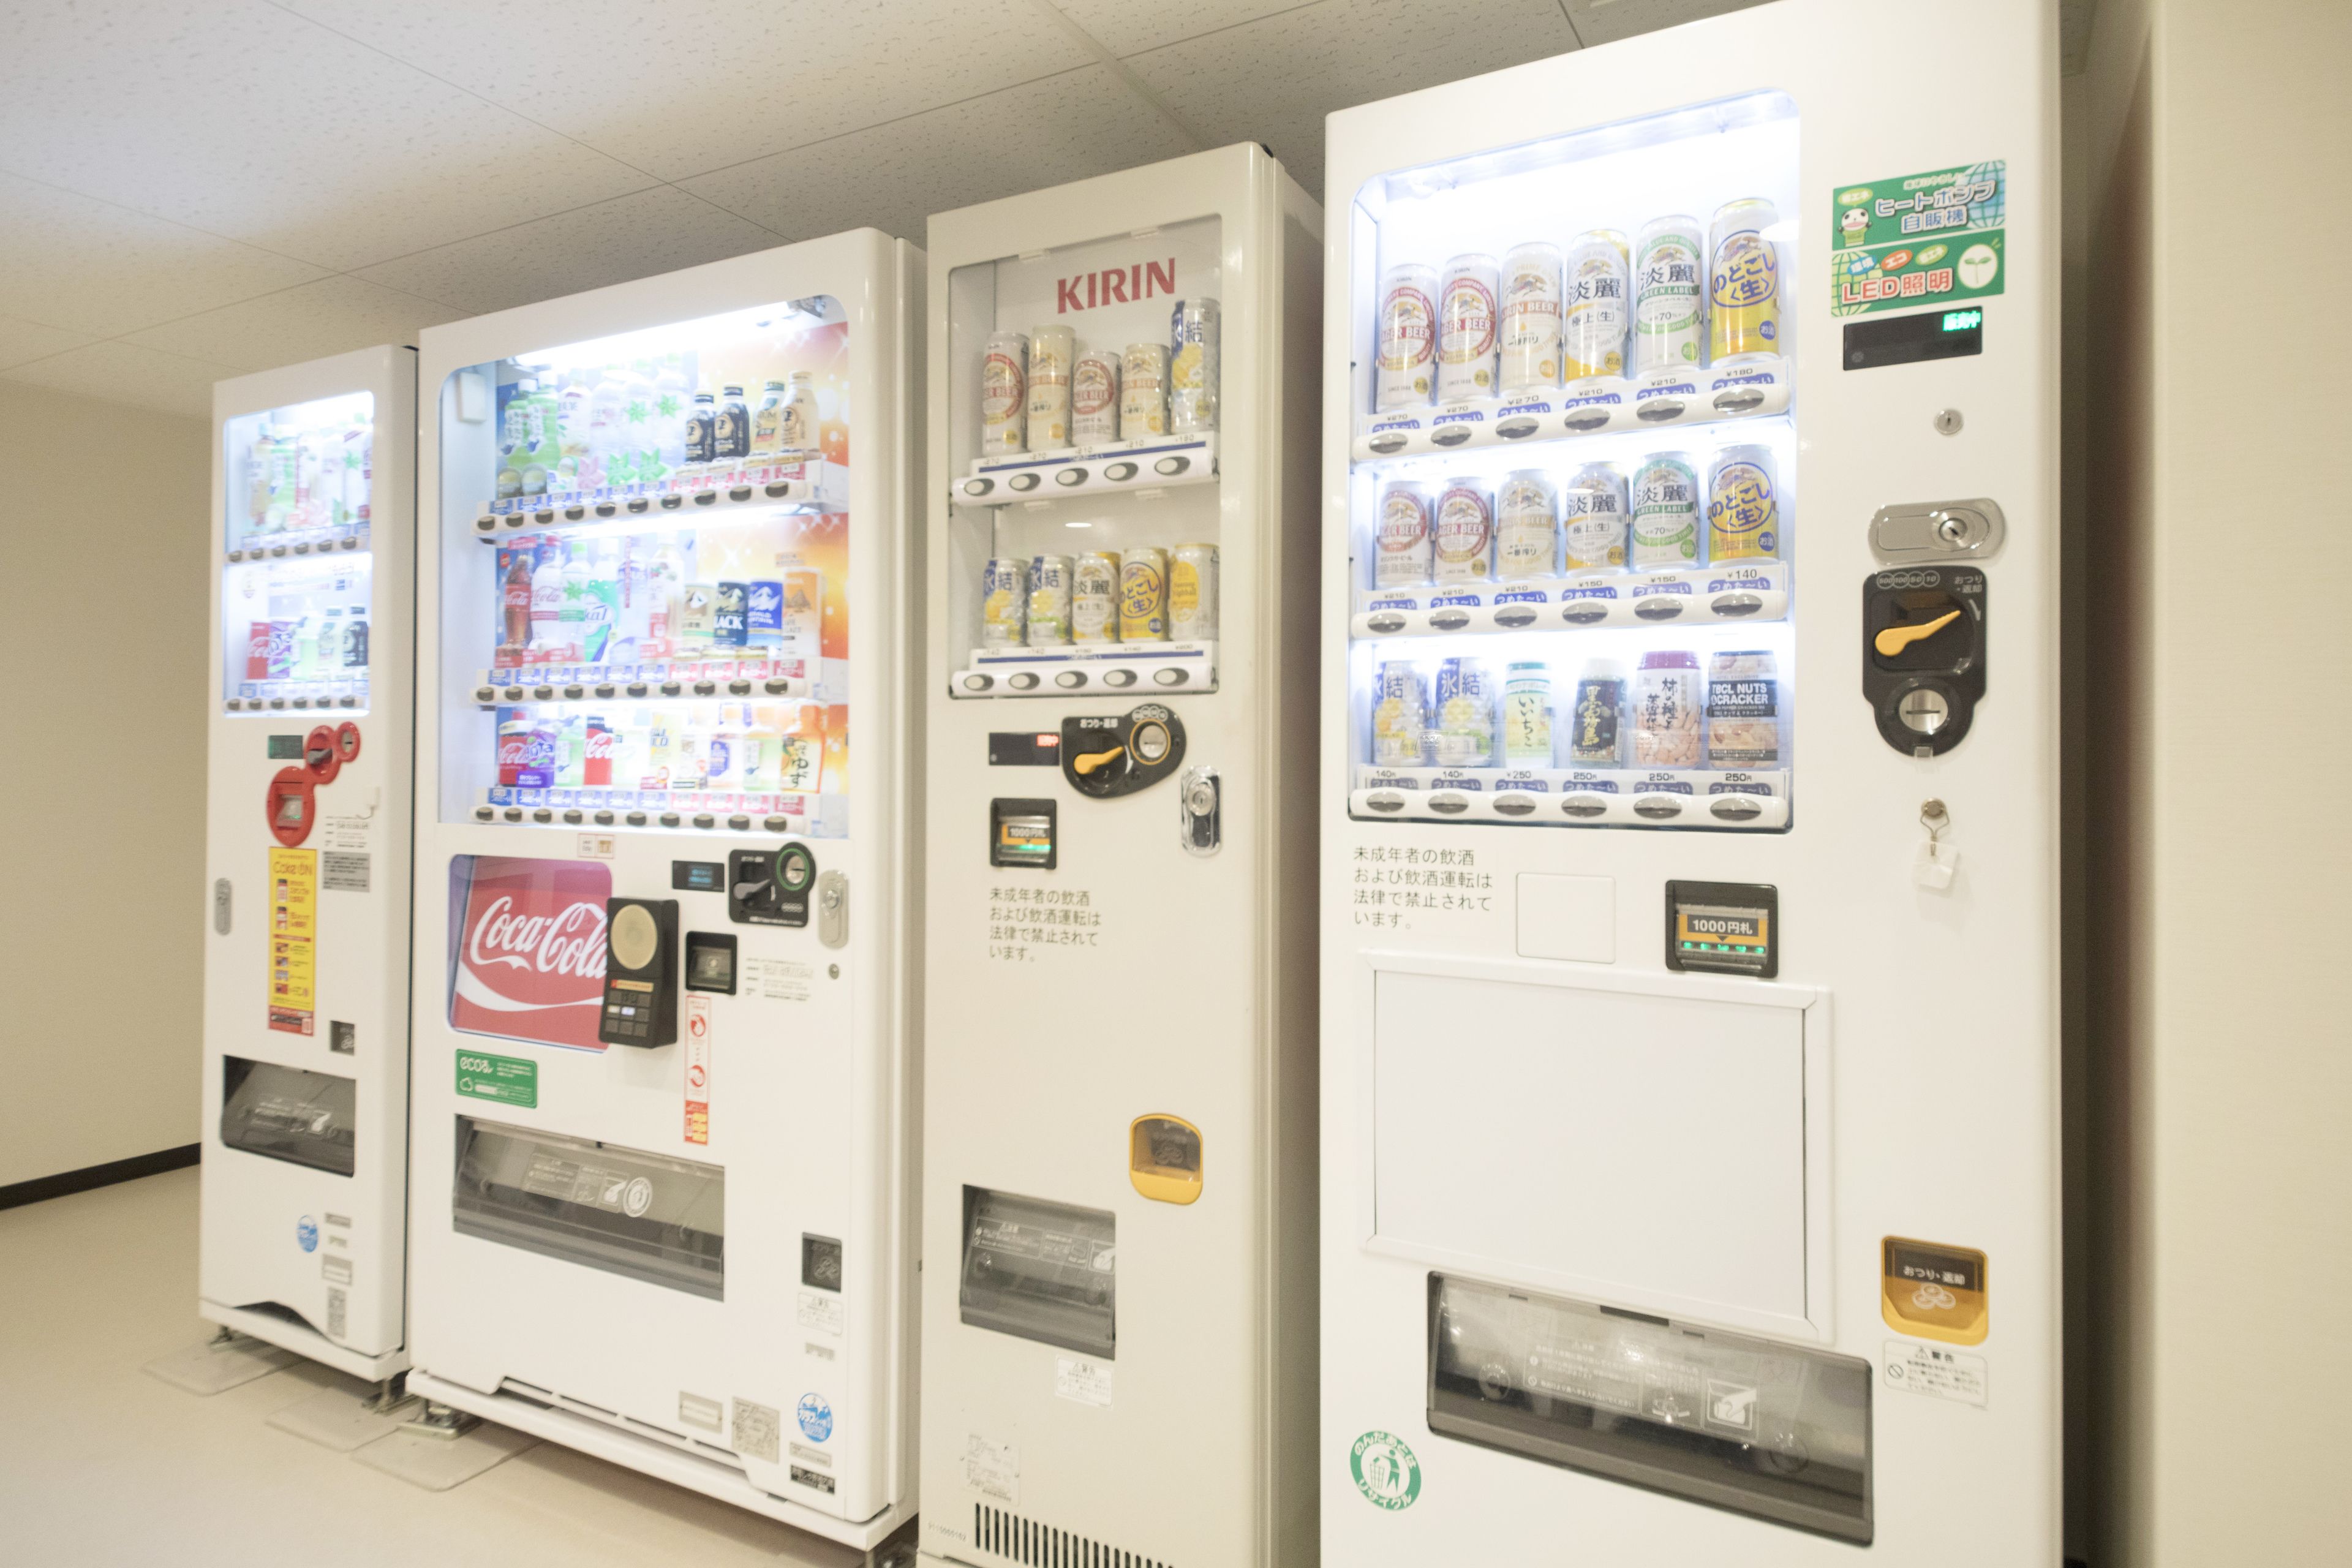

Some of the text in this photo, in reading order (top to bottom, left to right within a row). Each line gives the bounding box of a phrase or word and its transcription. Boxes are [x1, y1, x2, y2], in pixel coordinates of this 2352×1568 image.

[1875, 179, 1996, 217] ヒートポンプ
[1901, 205, 1967, 234] 自販機
[1885, 252, 1908, 269] エコ
[1640, 263, 1695, 291] 淡麗
[1714, 253, 1775, 293] のどごし
[1057, 257, 1175, 314] KIRIN
[1569, 277, 1621, 306] 淡麗
[1641, 285, 1693, 299] GREEN LABEL
[1842, 267, 1953, 304] LED照明
[1528, 301, 1554, 313] BEER
[1406, 326, 1430, 339] BEER
[1466, 318, 1491, 331] BEER
[1637, 484, 1687, 506] 淡麗
[1712, 483, 1770, 518] のどごし
[1567, 494, 1617, 518] 淡麗
[1400, 524, 1421, 535] BEER
[1462, 524, 1484, 536] BEER
[1076, 579, 1110, 595] 淡麗
[1954, 575, 1983, 584] おつり
[1441, 673, 1480, 696] 氷結
[1736, 683, 1768, 693] NUTS
[1518, 696, 1534, 747] いいちこ
[1574, 772, 1597, 781] 250円
[1649, 772, 1675, 782] 250円
[1725, 773, 1752, 782] 250円
[1354, 846, 1474, 866] 未成年者の飲酒
[1355, 867, 1493, 888] および飲酒運転は
[989, 888, 1090, 907] 未成年者の飲酒
[1354, 889, 1492, 911] 法律で禁止されて
[989, 907, 1101, 927] および飲酒運転は
[1355, 910, 1411, 930] います。
[1693, 919, 1753, 935] 1000円札
[989, 925, 1098, 947] 法律で禁止されて
[989, 945, 1035, 963] います。
[1354, 1431, 1417, 1469] のんだあとは
[1357, 1479, 1412, 1510] リサイクル
